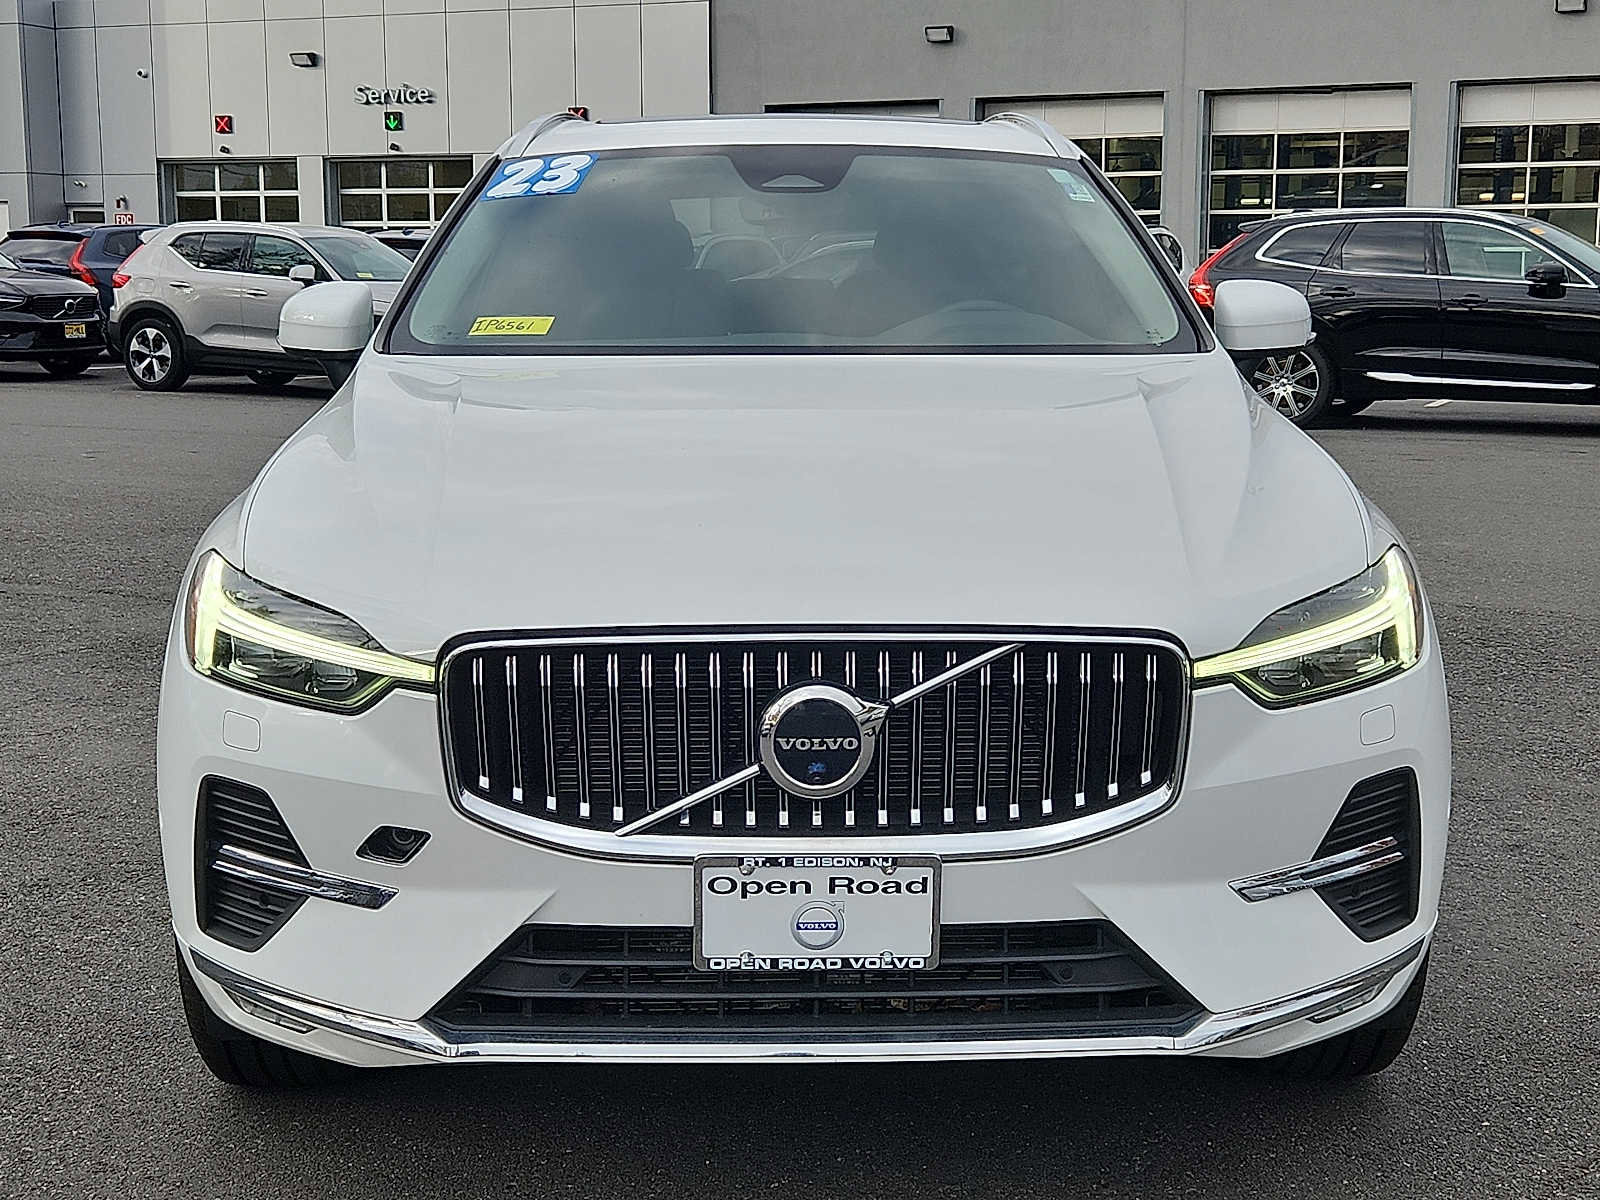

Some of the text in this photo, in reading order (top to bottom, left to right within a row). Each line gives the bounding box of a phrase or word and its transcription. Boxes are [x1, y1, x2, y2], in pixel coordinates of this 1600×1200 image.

[354, 83, 434, 105] Service
[486, 154, 594, 199] 23
[116, 214, 132, 225] FDC
[471, 319, 535, 333] IP6561
[775, 737, 859, 750] VOLVO
[743, 857, 893, 868] RT. 1 EDISON, NJ
[707, 876, 929, 900] Open Road
[798, 922, 837, 930] VOLVO
[709, 957, 925, 970] OPEN ROAD VOLVO
